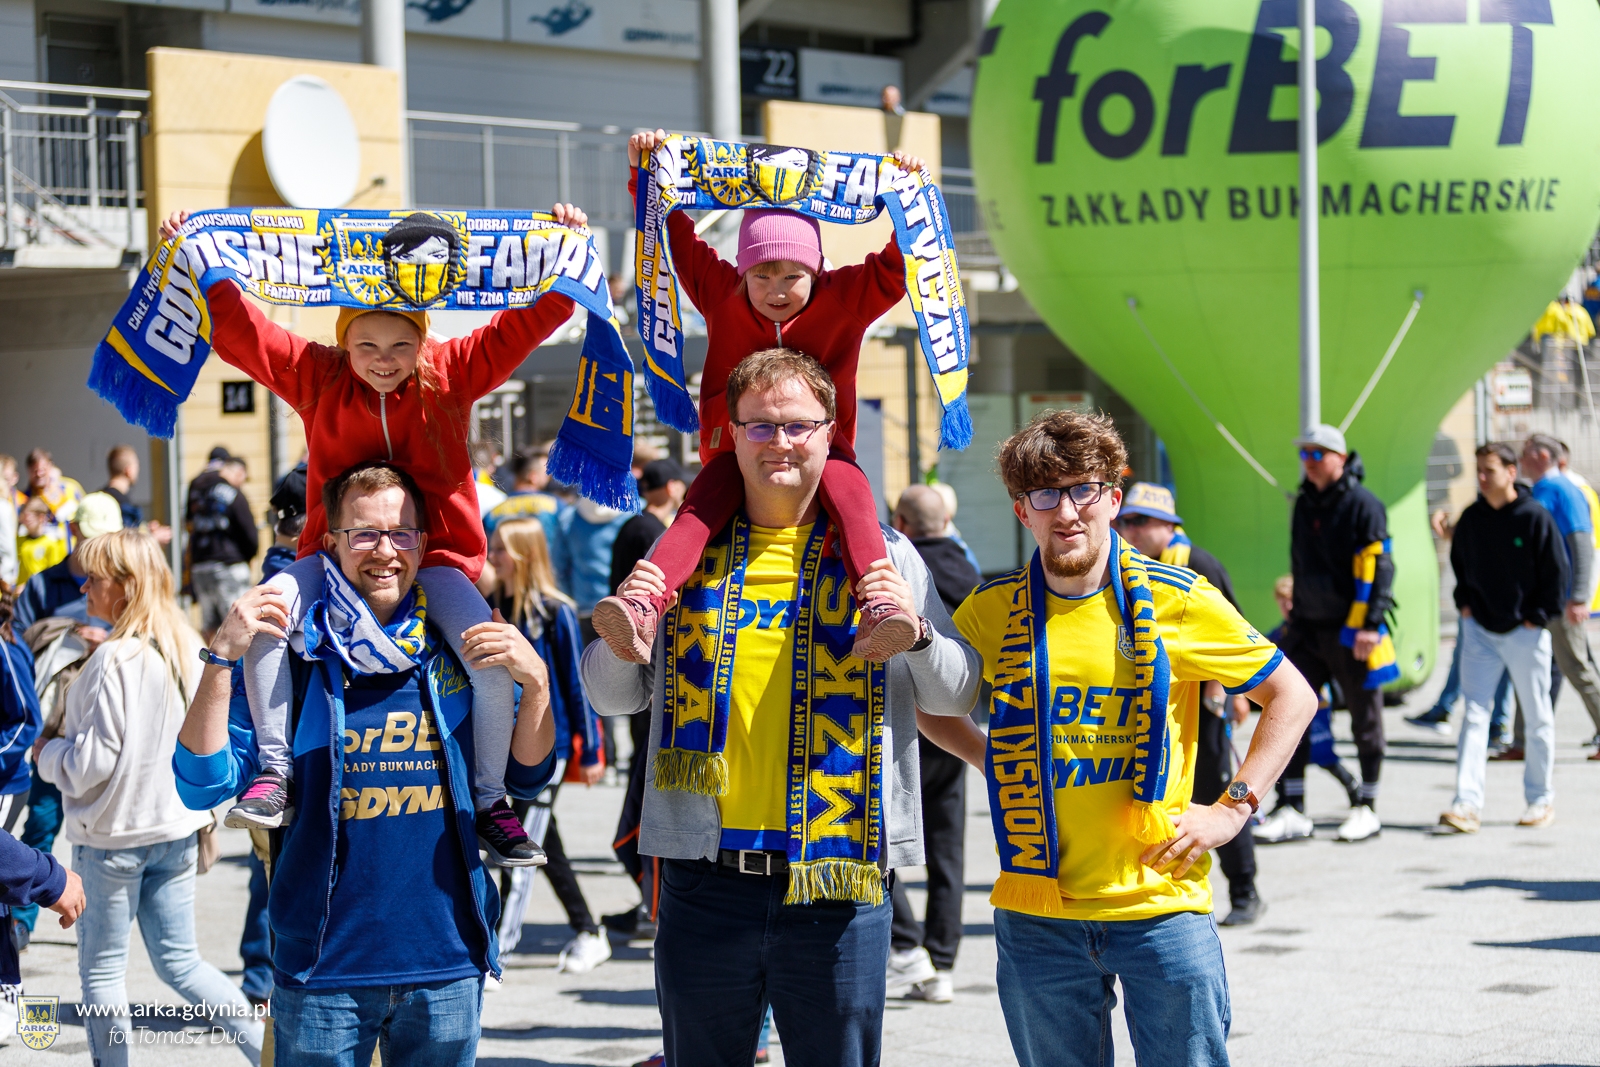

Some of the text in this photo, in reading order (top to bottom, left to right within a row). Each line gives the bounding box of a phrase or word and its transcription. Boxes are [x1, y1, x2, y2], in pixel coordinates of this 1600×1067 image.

[1033, 0, 1554, 164] forBET
[711, 167, 747, 178] ARK
[466, 218, 509, 231] DOBRA
[810, 198, 828, 216] NIE
[829, 204, 852, 220] ZNA
[1040, 188, 1210, 228] ZAKŁADY
[127, 298, 150, 331] CAŁE
[141, 265, 163, 302] ŻYCIE
[156, 245, 171, 266] NA
[252, 214, 305, 230] SZLAKU
[347, 265, 386, 276] ARK
[642, 259, 654, 277] NA
[264, 282, 331, 302] FANATYZM
[456, 290, 476, 305] NIE
[479, 291, 505, 305] ZNA
[641, 277, 652, 312] ŻYCIE
[736, 598, 798, 630] DYN
[676, 543, 731, 729] RKA
[795, 606, 810, 662] JESTEM
[663, 645, 675, 713] TWARDY!
[795, 669, 807, 691] BO
[1050, 686, 1138, 727] BET
[344, 710, 441, 754] orBE
[792, 698, 808, 757] DUMNY,
[1050, 734, 1136, 744] BUKMACHERSKI
[344, 759, 446, 773] ŁADY BUKMACHE
[870, 743, 883, 775] NAD
[339, 784, 446, 821] GDYNI
[790, 763, 804, 816] JESTEM
[989, 724, 1047, 870] MORSKI
[790, 820, 803, 841] JA
[868, 797, 881, 848] JESTEM
